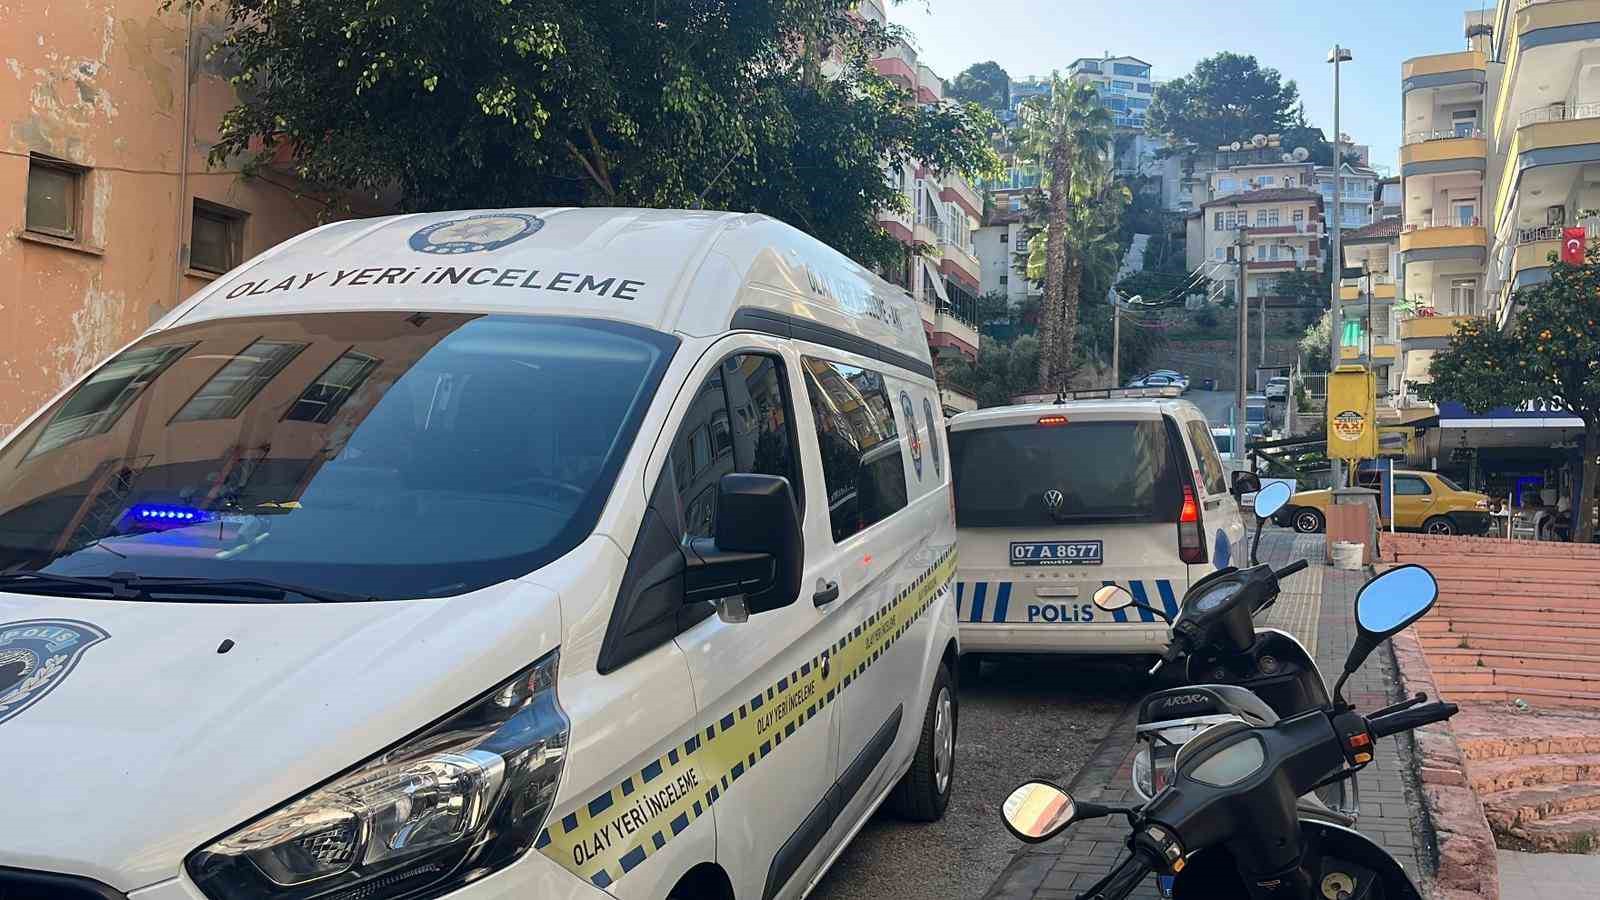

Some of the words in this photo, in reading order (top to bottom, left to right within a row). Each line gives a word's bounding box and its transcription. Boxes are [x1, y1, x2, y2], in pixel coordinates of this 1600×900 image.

[226, 271, 327, 300] OLAY
[1014, 546, 1035, 558] 07
[1040, 546, 1052, 558] A
[1057, 545, 1098, 558] 8677
[757, 710, 773, 735] OLAY
[573, 824, 613, 866] OLAY
